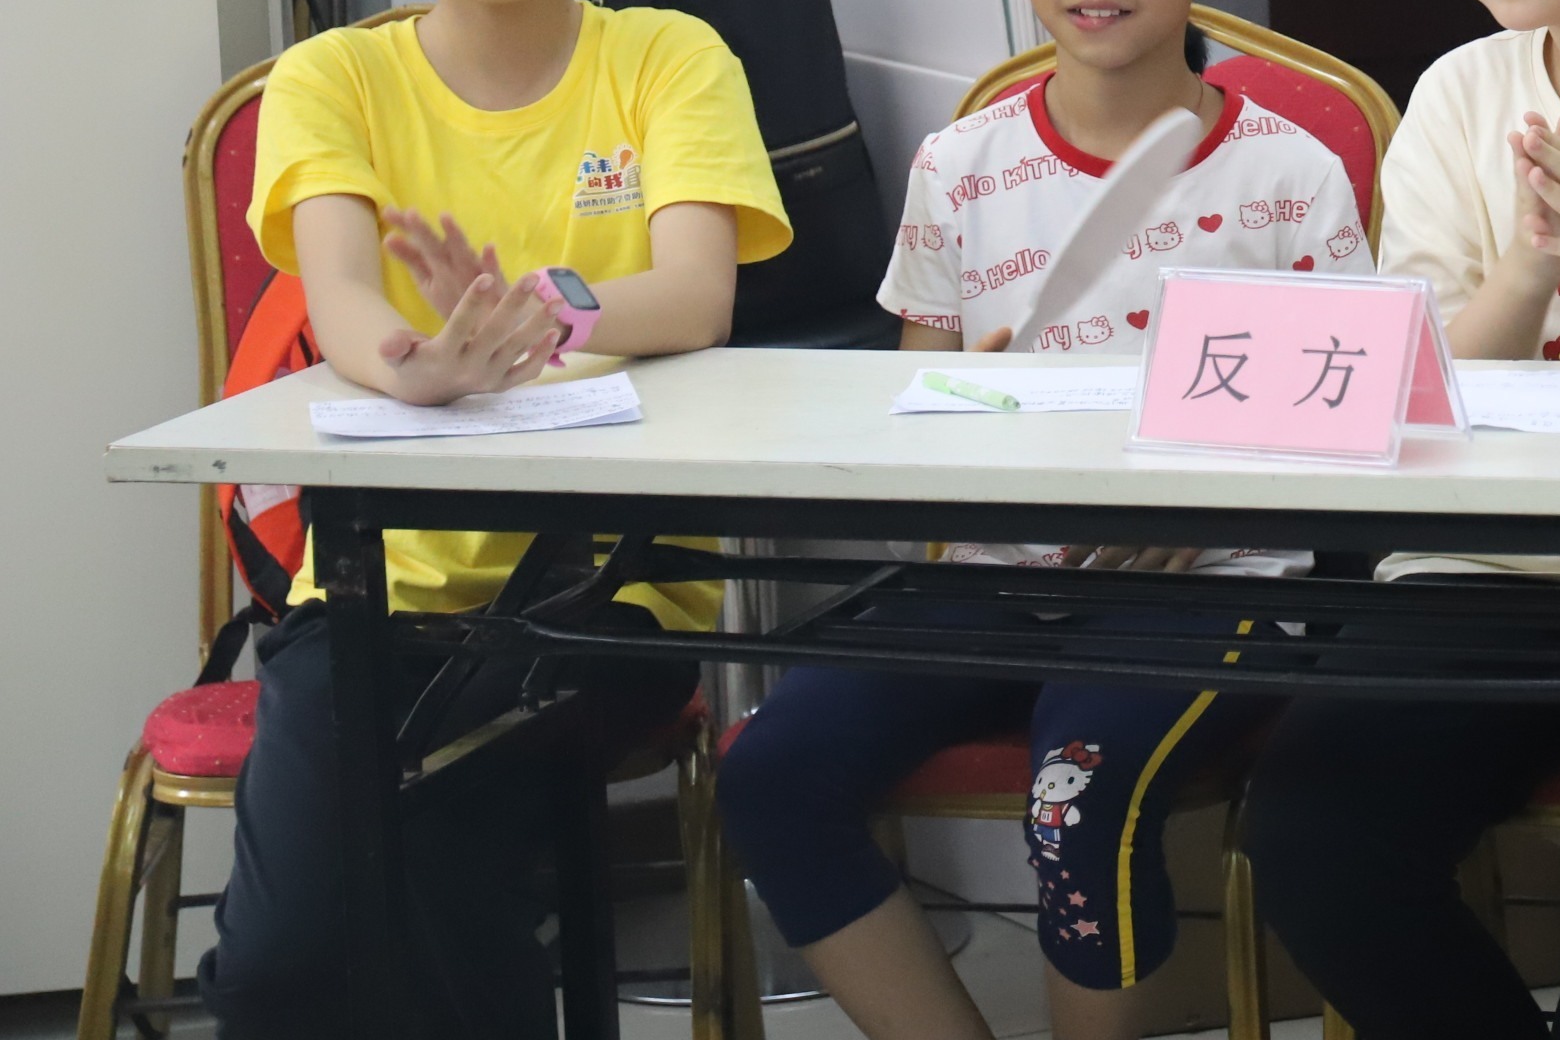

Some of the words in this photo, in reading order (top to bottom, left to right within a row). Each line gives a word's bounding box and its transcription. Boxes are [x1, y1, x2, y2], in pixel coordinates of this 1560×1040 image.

[588, 172, 623, 189] 的我
[946, 174, 996, 212] ello
[986, 248, 1051, 290] Hello
[1182, 331, 1367, 409] 反方
